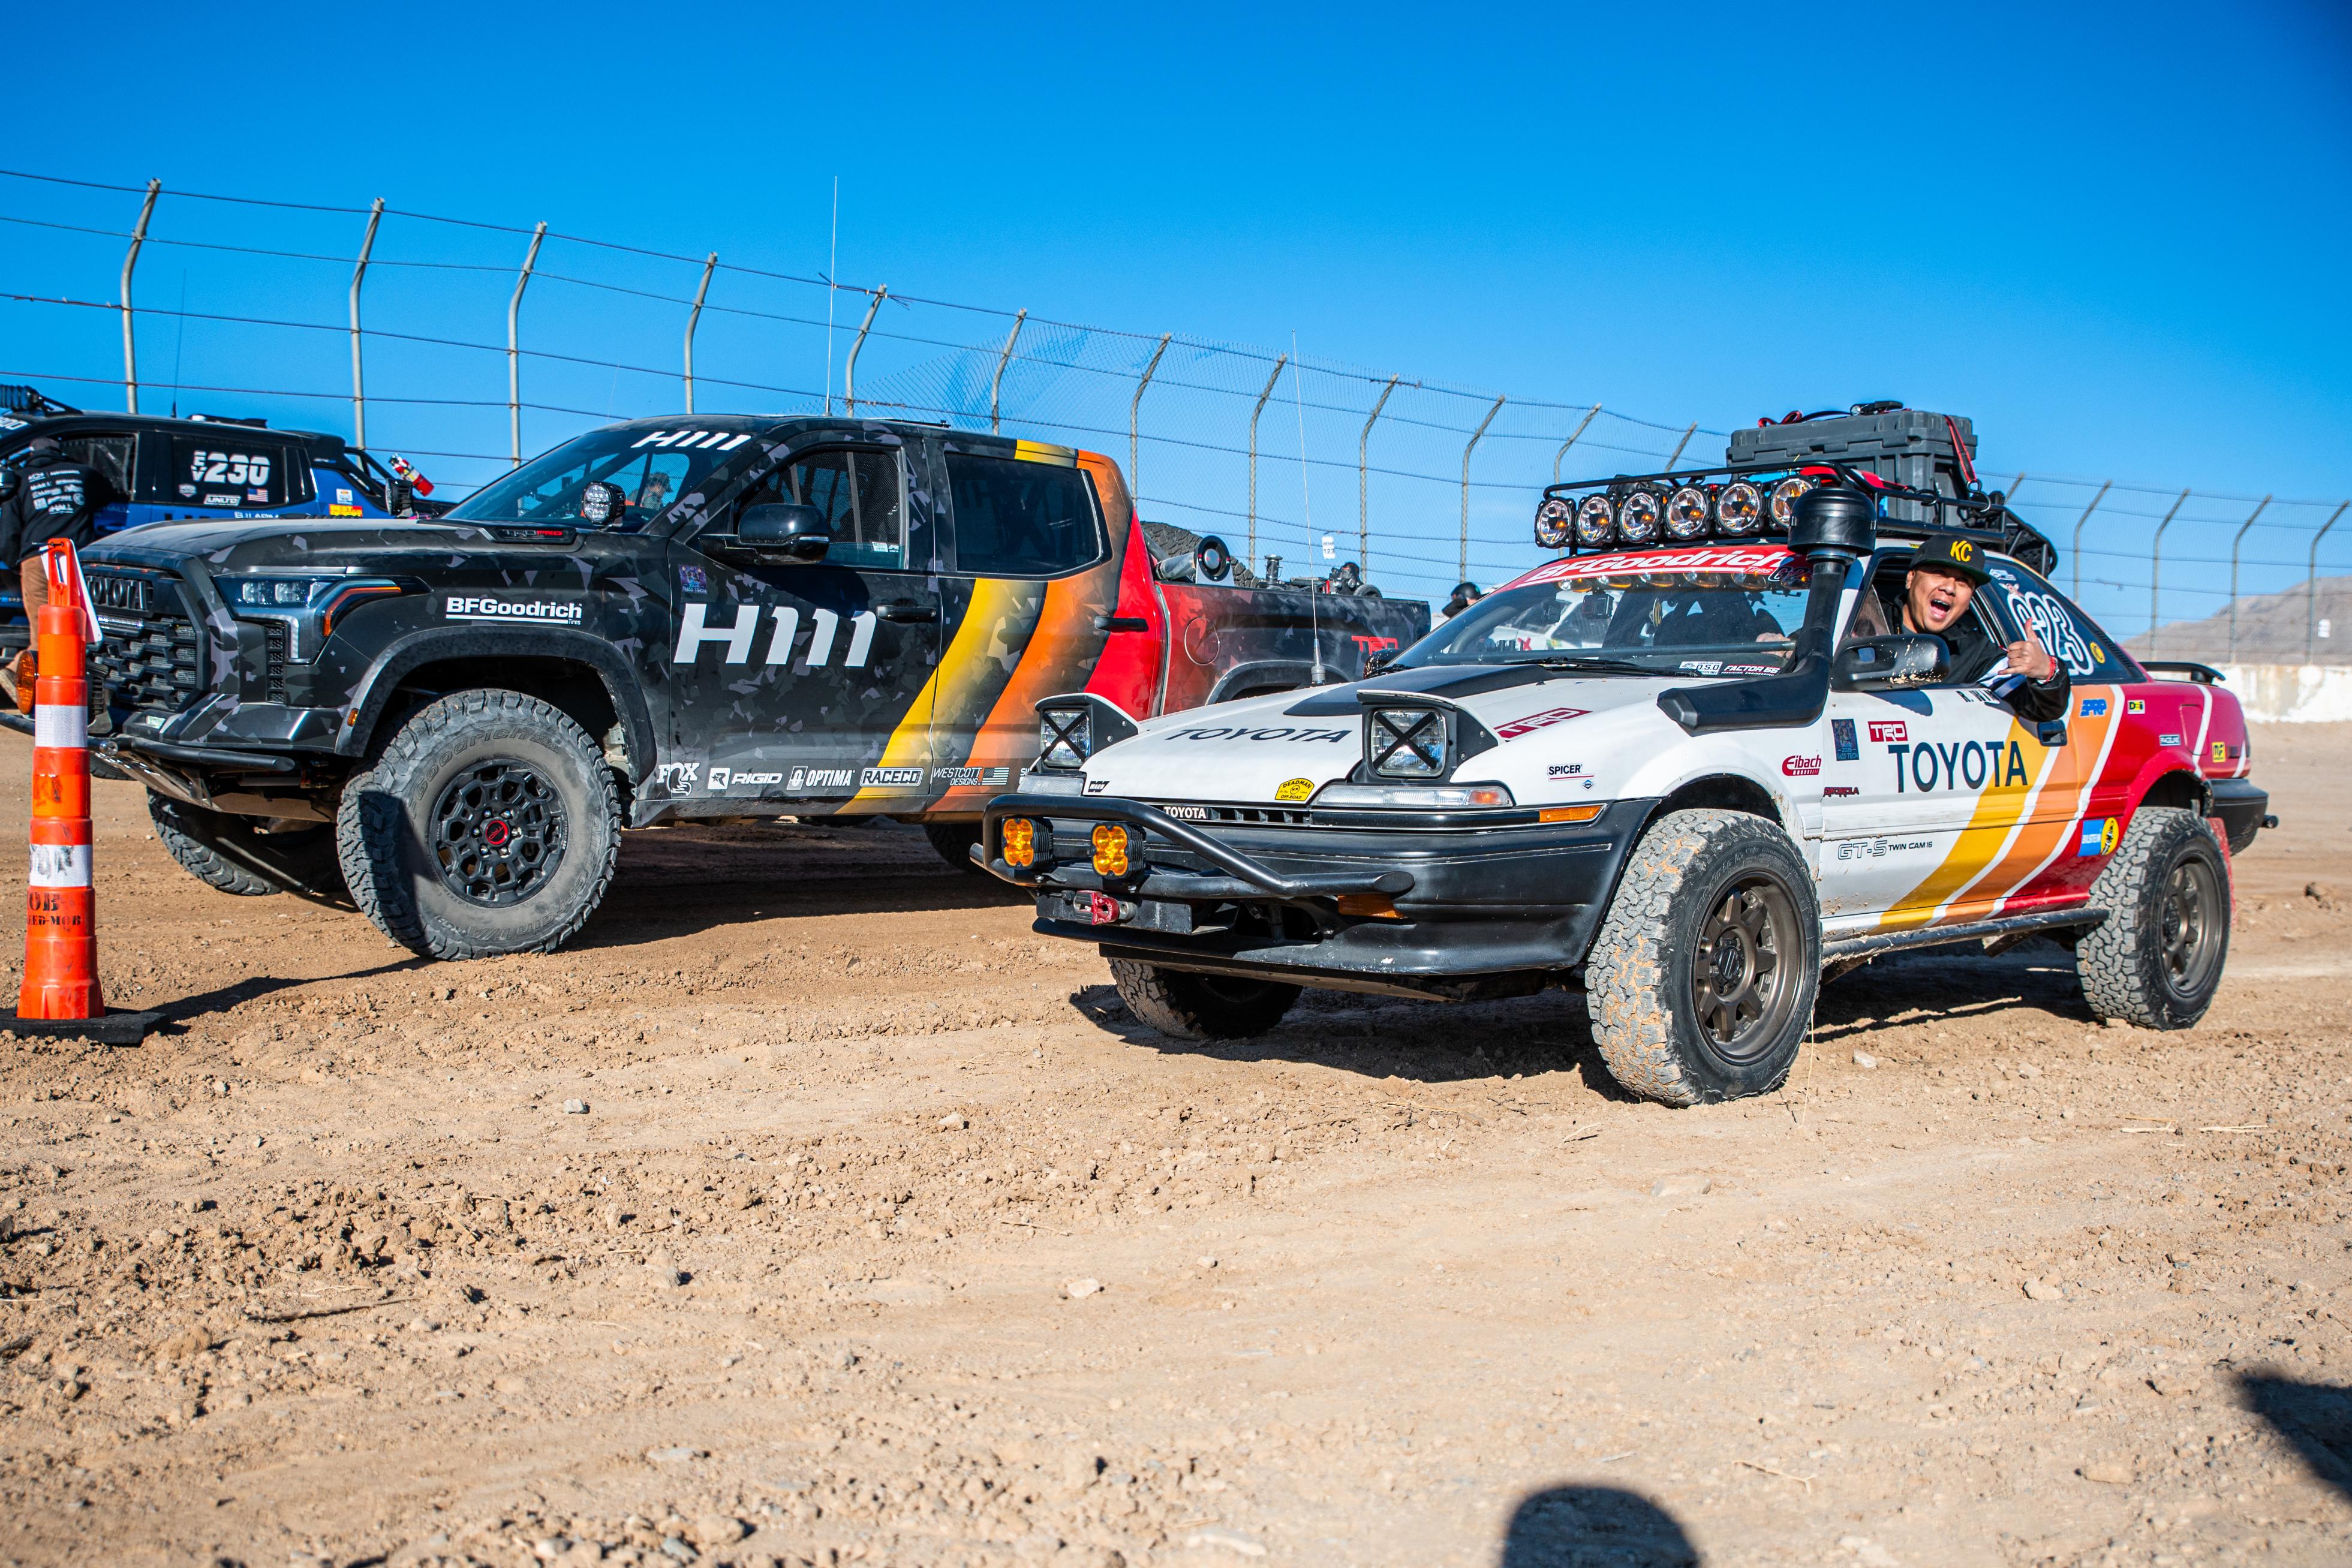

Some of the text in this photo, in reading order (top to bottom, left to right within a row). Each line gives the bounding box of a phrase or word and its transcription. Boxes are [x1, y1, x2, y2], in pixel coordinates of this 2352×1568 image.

[630, 431, 751, 451] H111
[204, 452, 270, 486] 230
[1950, 540, 1973, 562] KC
[1532, 550, 1789, 582] BFGoodrich
[446, 597, 582, 619] BFGoodrich
[673, 603, 876, 667] H111
[1496, 710, 1580, 733] TRD
[1165, 728, 1353, 743] TOYOTA
[1870, 724, 1906, 741] TRD
[933, 767, 982, 778] WESTCOTT
[1548, 765, 1581, 775] SPICER
[1782, 755, 1822, 776] Eibach
[1888, 741, 2028, 793] TOYOTA
[657, 762, 700, 796] FOX
[731, 773, 783, 784] RIGID
[807, 769, 853, 787] OPTIMA
[862, 771, 919, 784] RACECO
[1283, 780, 1312, 789] DEADMAN
[1164, 807, 1207, 819] TOYOTA
[1838, 840, 1887, 860] GT-S
